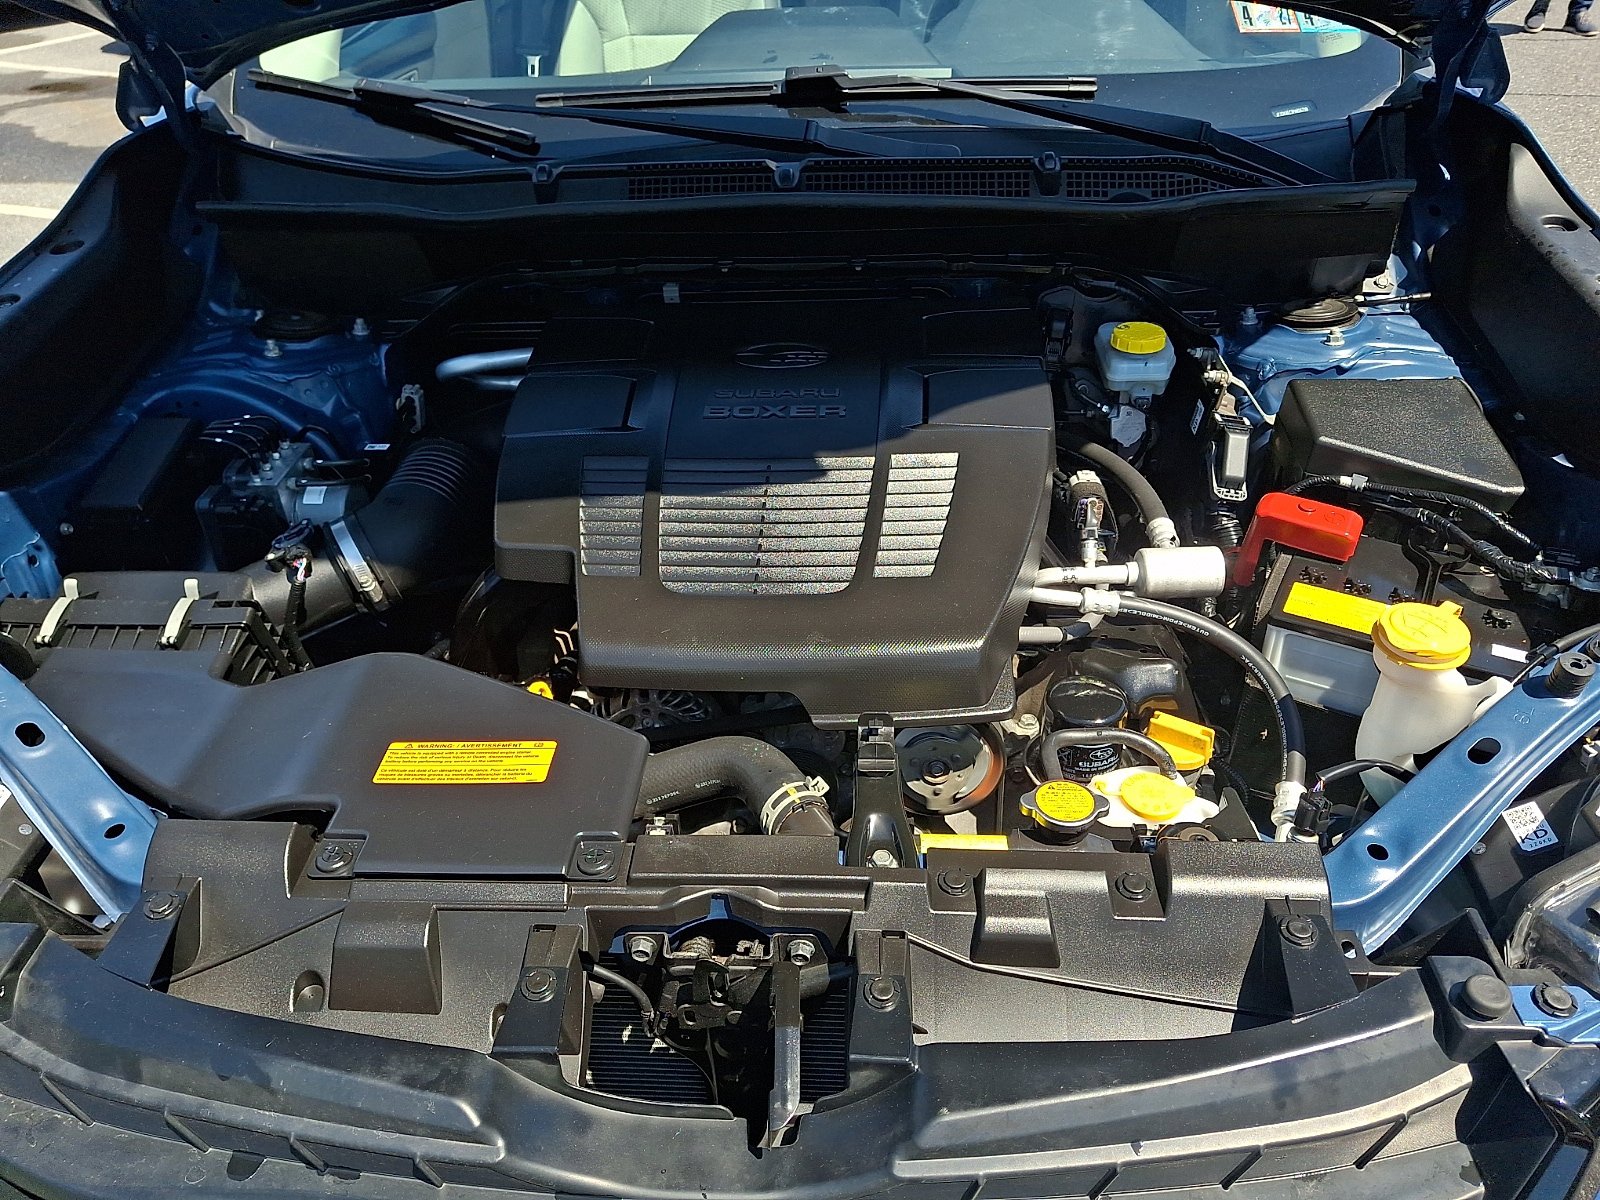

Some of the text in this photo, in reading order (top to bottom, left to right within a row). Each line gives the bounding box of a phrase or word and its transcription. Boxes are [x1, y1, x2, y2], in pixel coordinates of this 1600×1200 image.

[1242, 6, 1254, 26] 4
[714, 388, 841, 399] SUBARU
[702, 405, 848, 420] BOXER
[1078, 754, 1118, 768] SUBARU
[1519, 828, 1548, 844] KD
